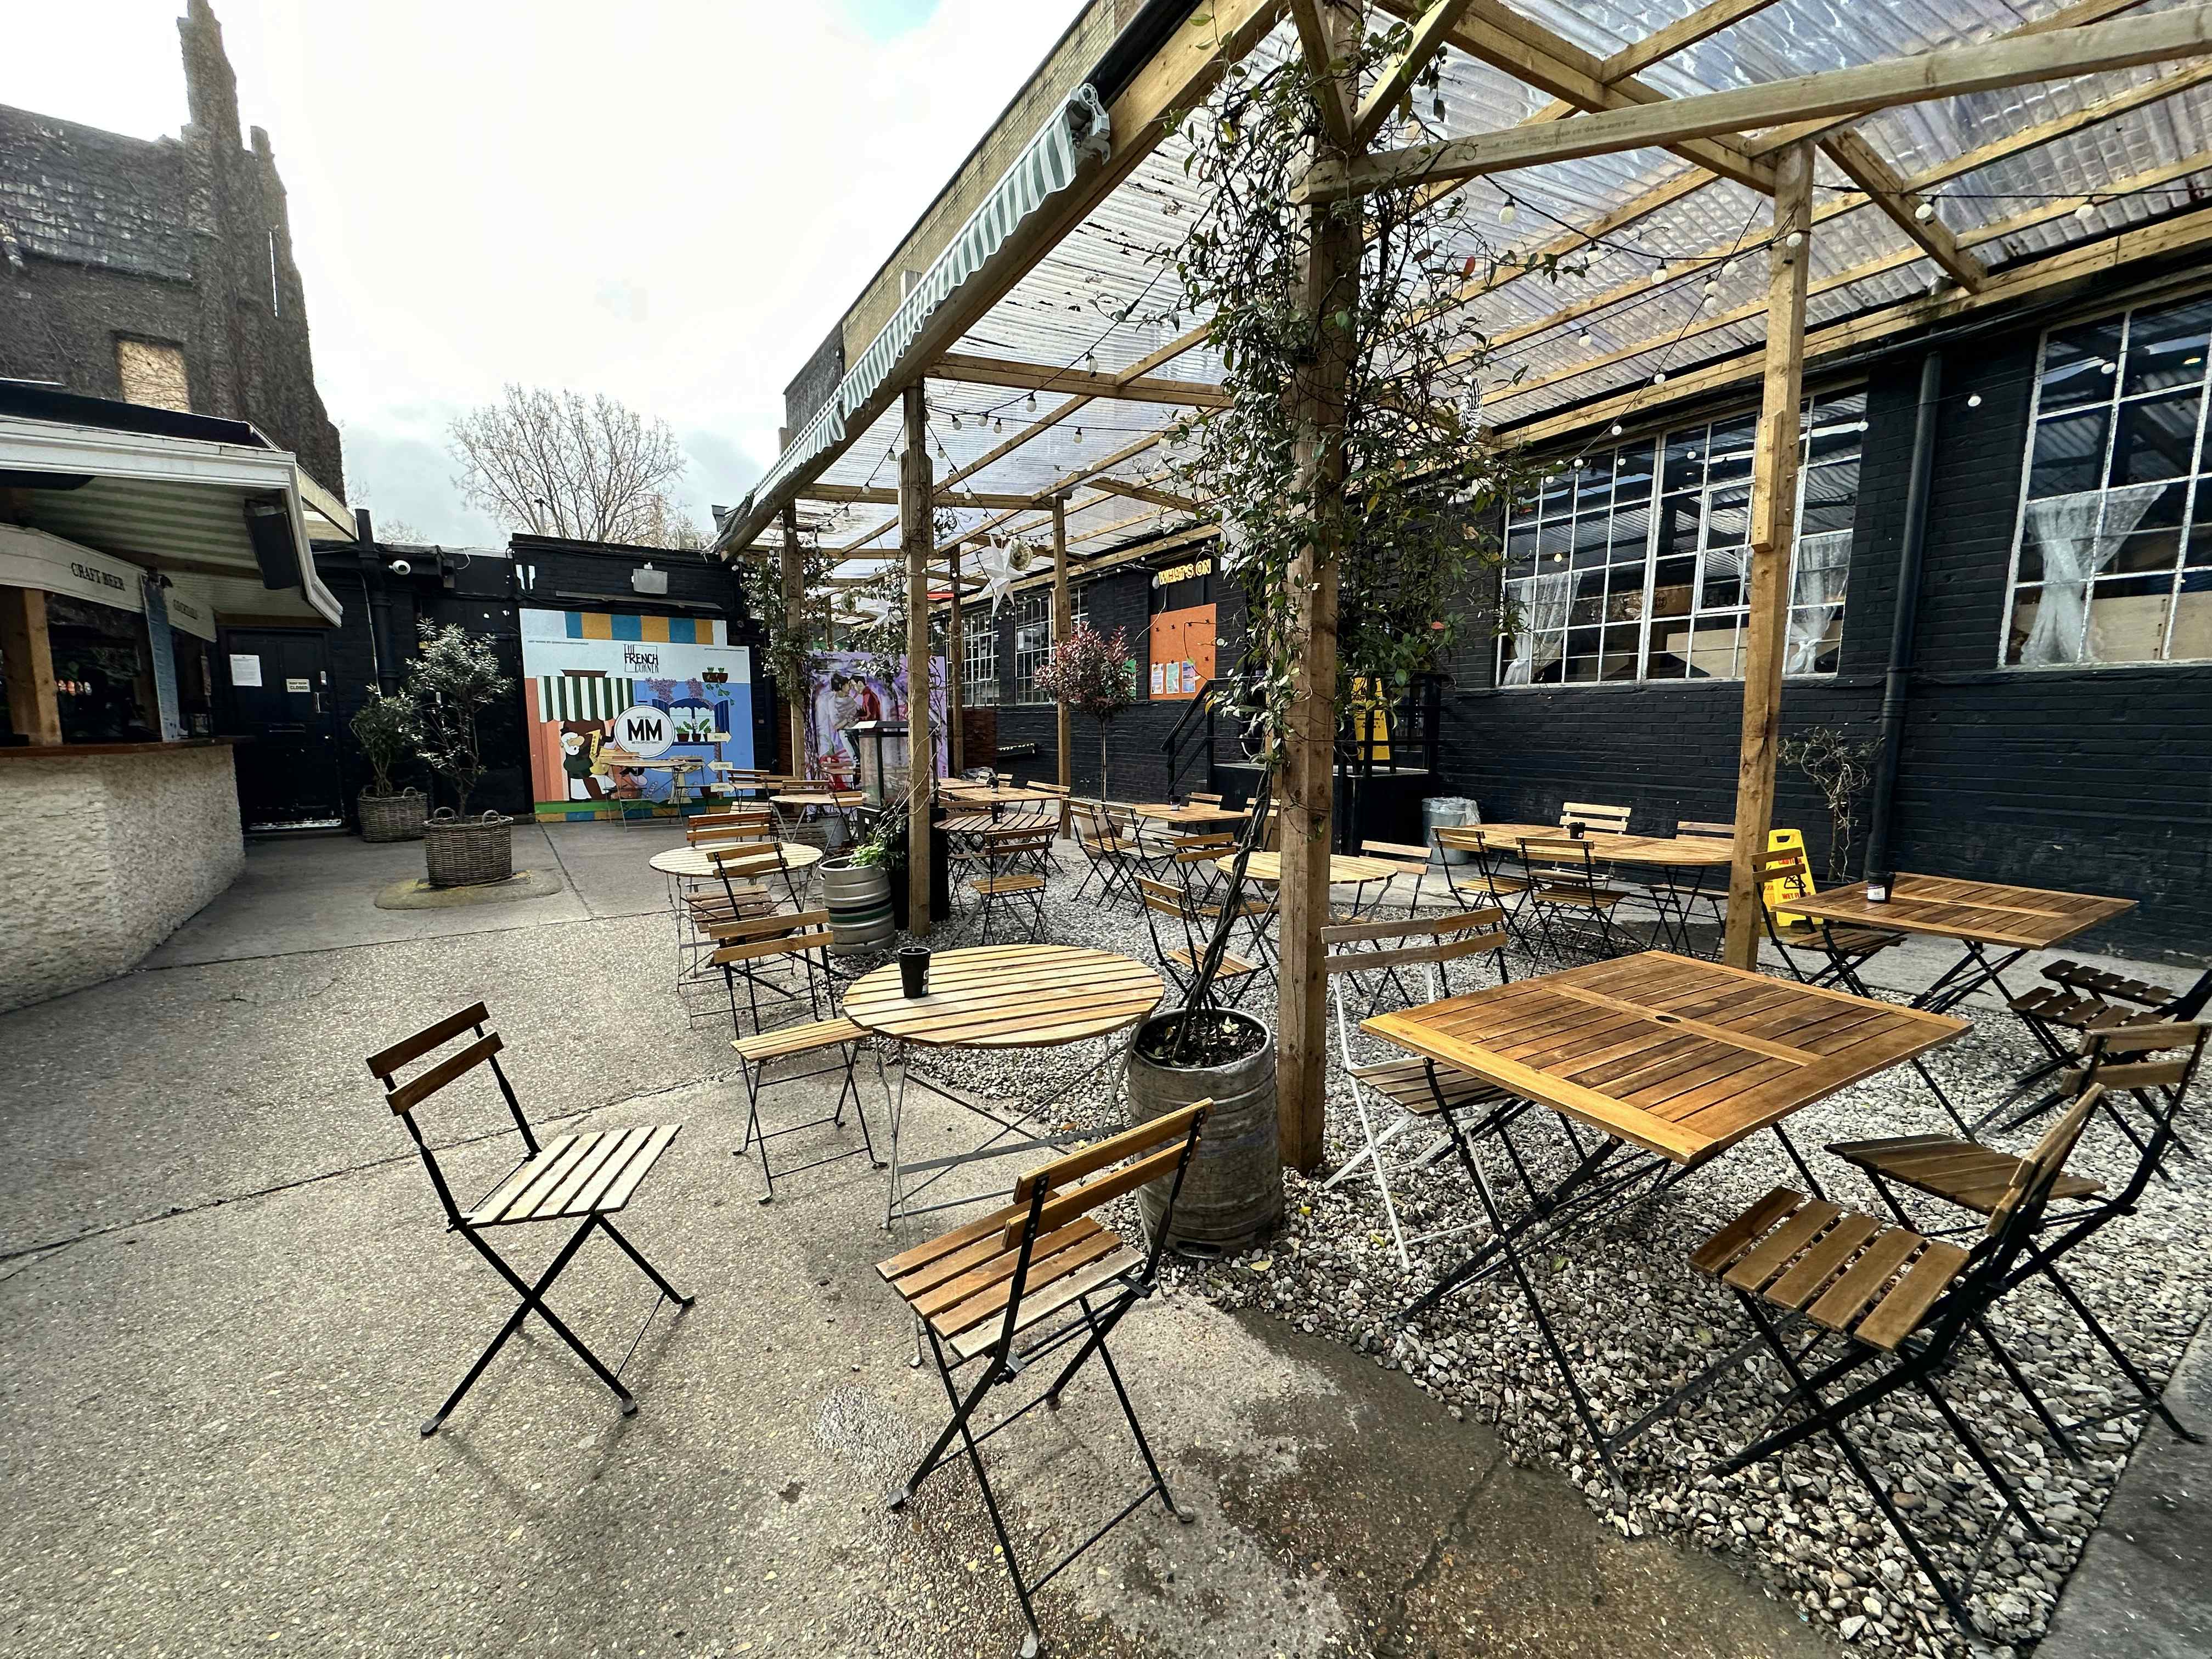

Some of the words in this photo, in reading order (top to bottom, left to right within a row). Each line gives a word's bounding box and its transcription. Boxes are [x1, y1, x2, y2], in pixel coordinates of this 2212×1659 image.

[71, 562, 101, 584] CRAFT
[102, 572, 126, 591] BEER
[1158, 563, 1194, 585] WHAT'S
[1196, 558, 1211, 576] ON
[624, 653, 659, 664] FRENCH
[635, 662, 659, 673] CORNER
[627, 719, 662, 741] MM
